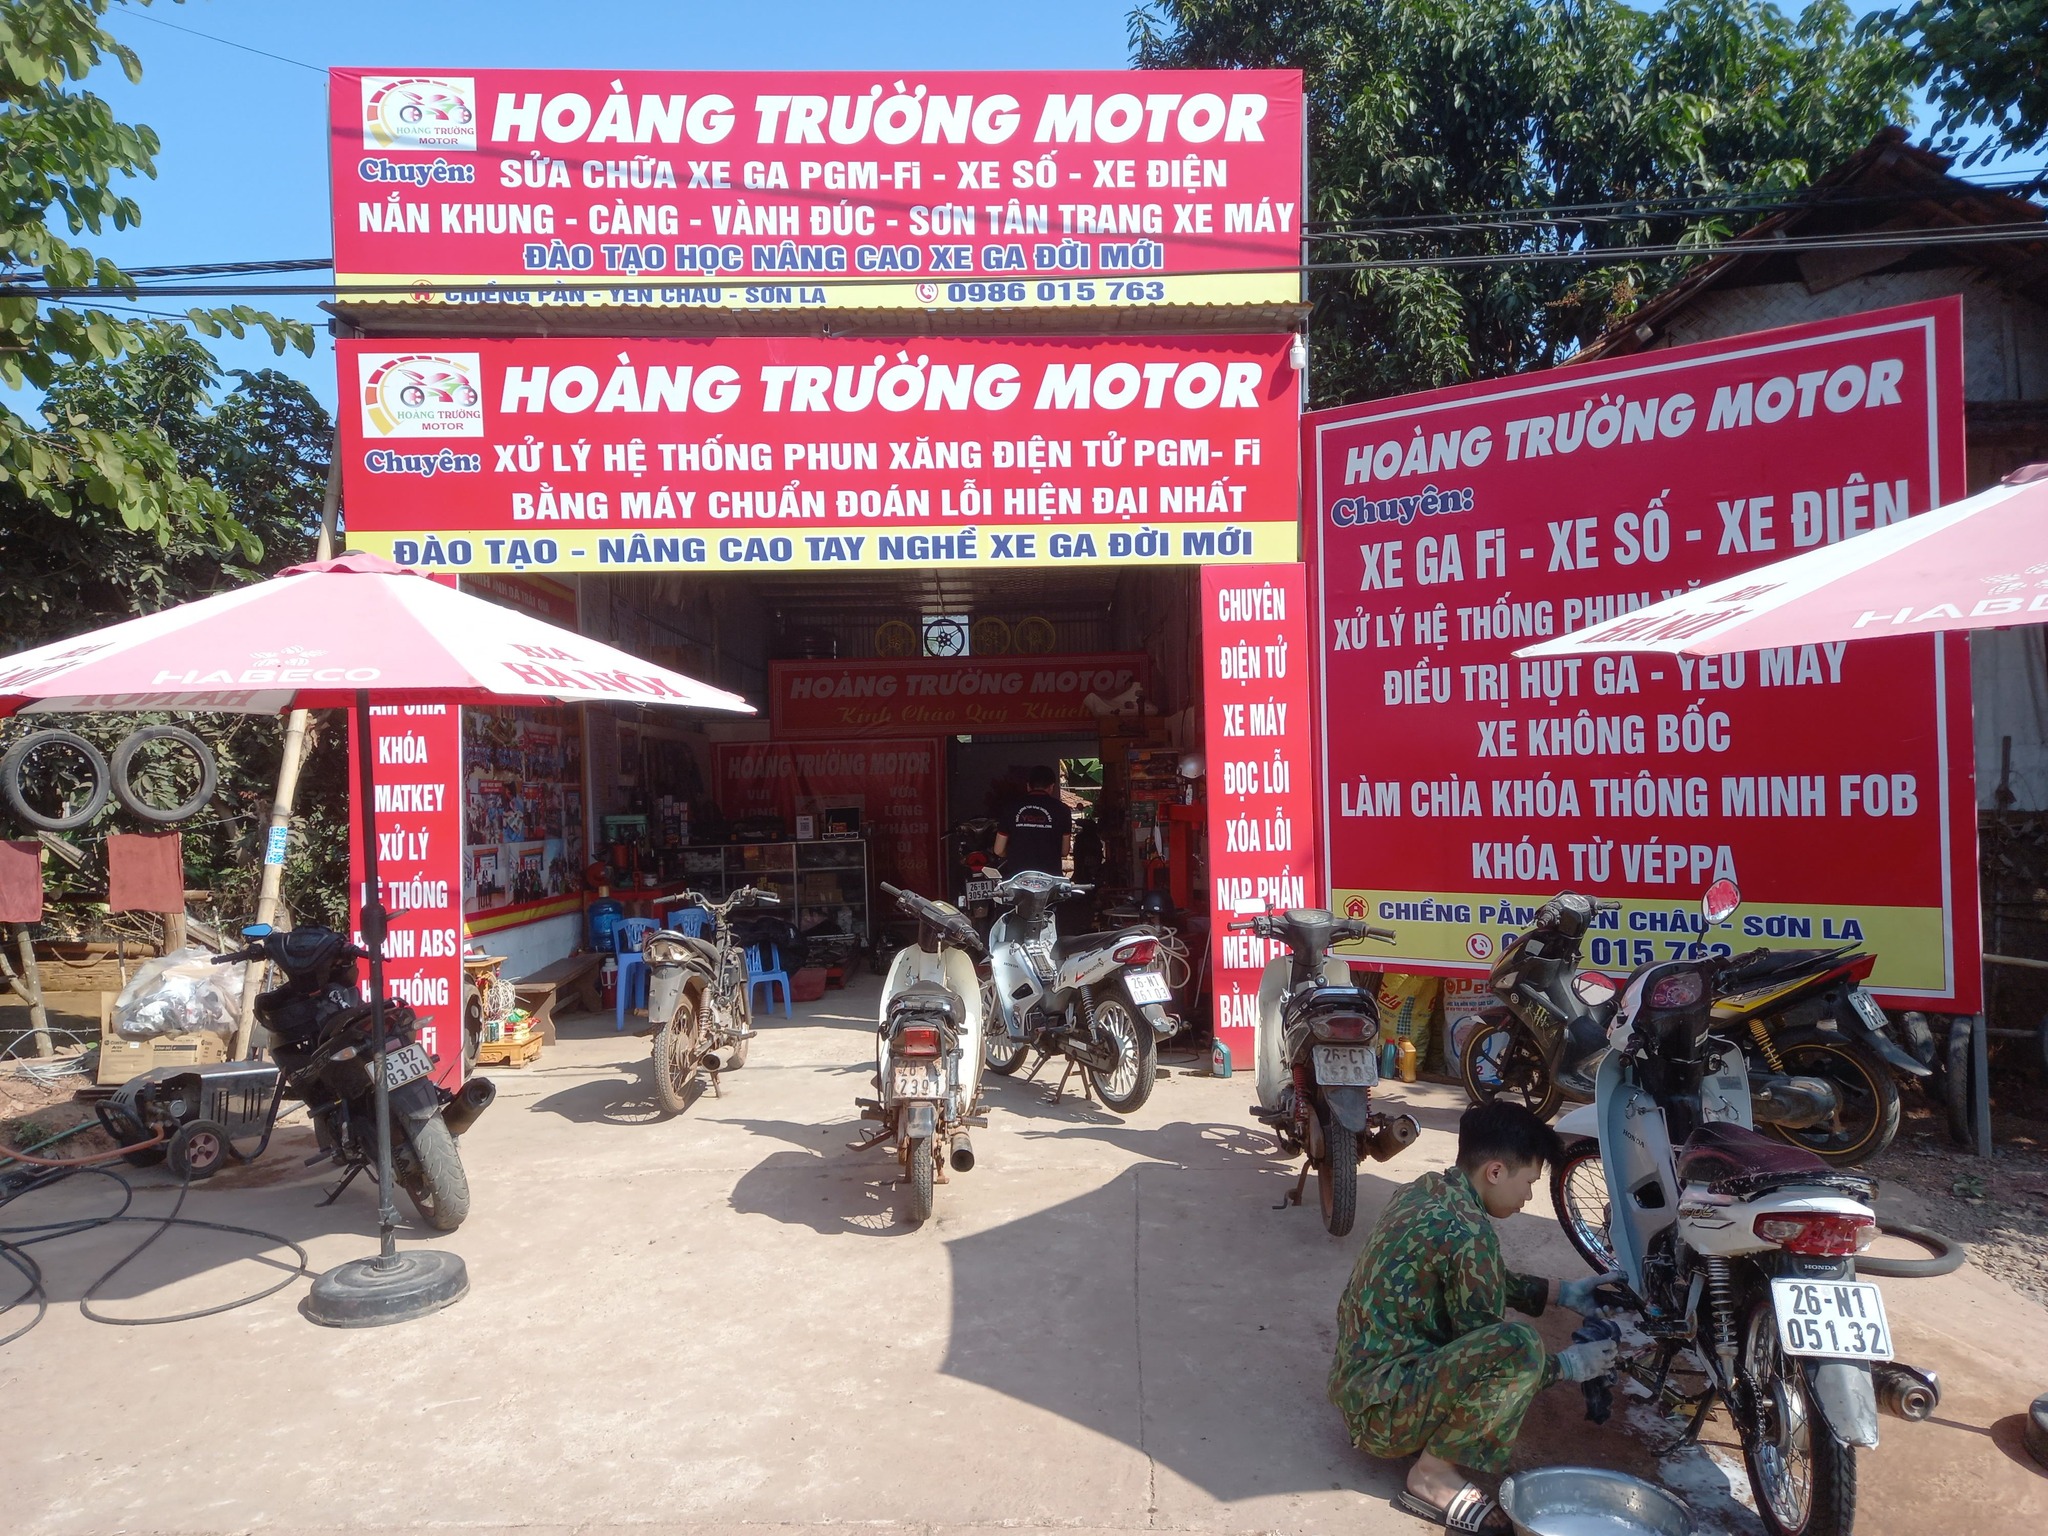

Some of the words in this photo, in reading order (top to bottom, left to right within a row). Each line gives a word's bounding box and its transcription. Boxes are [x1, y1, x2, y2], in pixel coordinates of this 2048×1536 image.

[490, 78, 735, 144] HOÀNG
[754, 79, 1020, 145] TRƯỜNG
[1033, 93, 1267, 145] MOTOR
[359, 158, 475, 185] Chuyên:
[500, 150, 570, 189] SỬA
[583, 154, 675, 189] CHỮA
[688, 160, 731, 190] XE
[743, 160, 789, 189] GA
[957, 160, 999, 190] XE
[1012, 150, 1057, 189] SỐ
[1093, 159, 1136, 189] XE
[1147, 154, 1227, 194] ĐIỆN
[359, 191, 430, 234] NẮN
[442, 203, 555, 235] KHUNG
[589, 199, 679, 236] CÀNG
[712, 199, 799, 235] VÀNH
[810, 200, 875, 236] ĐÚC
[909, 202, 975, 236] SƠN
[986, 199, 1047, 235] TÂN
[1059, 203, 1162, 235] TRANG
[1173, 203, 1213, 233] XE
[1224, 197, 1295, 233] MÁY
[524, 241, 592, 271] ĐÀO
[602, 244, 665, 275] TẠO
[677, 245, 741, 275] HỌC
[754, 242, 845, 271] NÂNG
[856, 245, 919, 271] CAO
[932, 245, 971, 271] XE
[983, 245, 1025, 271] GA
[1035, 240, 1090, 270] ĐỜI
[1100, 240, 1163, 269] MỚI
[800, 287, 826, 303] LA
[947, 282, 1026, 302] 0986
[1037, 281, 1095, 301] 015
[1105, 281, 1164, 300] 763
[500, 351, 741, 414] HOÀNG
[760, 350, 1021, 412] TRƯỜNG
[1033, 362, 1262, 410] MOTOR
[421, 422, 464, 431] MOTOR
[1344, 425, 1493, 486] HOÀNG
[1505, 392, 1696, 462] TRƯỜNG
[1706, 358, 1904, 432] MOTOR
[365, 448, 481, 477] Chuyên:
[494, 436, 544, 472] XỬ
[558, 438, 591, 472] LÝ
[604, 440, 646, 478] HỆ
[658, 434, 772, 472] THỐNG
[784, 443, 878, 471] PHUN
[888, 435, 981, 469] XĂNG
[993, 435, 1071, 474] ĐIỆN
[1082, 430, 1126, 467] TỬ
[512, 481, 608, 521] BẰNG
[620, 485, 696, 519] MÁY
[708, 479, 825, 519] CHUẨN
[836, 483, 930, 518] ĐOÁN
[941, 478, 992, 516] LỖI
[1004, 482, 1081, 521] HIỆN
[1092, 485, 1148, 520] ĐẠI
[1159, 476, 1246, 513] NHẤT
[1332, 484, 1474, 527] Chuyên:
[394, 535, 472, 566] ĐÀO
[485, 538, 558, 569] TẠO
[600, 533, 705, 563] NÂNG
[718, 536, 793, 563] CAO
[804, 535, 865, 561] TAY
[879, 526, 978, 561] NGHỀ
[990, 533, 1036, 558] XE
[1049, 532, 1097, 558] GA
[1108, 526, 1169, 557] ĐỜI
[1183, 526, 1252, 556] MỚI
[1360, 541, 1403, 591] XE
[1415, 534, 1464, 585] GA
[1476, 528, 1506, 579] Fi
[1548, 516, 1599, 572] XE
[1613, 489, 1671, 566] SỐ
[1717, 496, 1775, 555] XE
[1219, 581, 1286, 622] CHUYÊN
[1334, 606, 1371, 651] XỬ
[1376, 603, 1405, 646] LÝ
[1414, 603, 1448, 651] HỆ
[1457, 592, 1553, 641] THỐNG
[151, 668, 381, 685] HABECO
[1220, 639, 1260, 686] ĐIỆN
[1265, 634, 1287, 678] TỬ
[790, 670, 898, 700] HOÀNG
[906, 667, 1024, 696] TRƯỜNG
[1029, 670, 1134, 694] MOTOR
[1384, 656, 1450, 705] ĐIỀU
[1461, 662, 1509, 708] TRỊ
[1521, 658, 1582, 706] HỤT
[1593, 655, 1639, 696] GA
[1223, 704, 1245, 737] XE
[1250, 696, 1287, 736] MÁY
[1477, 720, 1517, 758] XE
[1529, 709, 1645, 756] KHÔNG
[1657, 698, 1731, 753] BỐC
[379, 730, 428, 764] KHÓA
[728, 750, 792, 779] HOÀNG
[869, 751, 930, 775] MOTOR
[1224, 761, 1258, 801] ĐỌC
[1264, 749, 1290, 794] LỖI
[1341, 775, 1401, 817] LÀM
[1411, 773, 1482, 818] CHÌA
[1491, 772, 1580, 817] KHÓA
[1590, 769, 1709, 818] THÔNG
[1722, 775, 1826, 817] MINH
[1840, 774, 1918, 817] FOB
[375, 784, 445, 812] MATKEY
[379, 824, 406, 861] XỬ
[409, 827, 429, 860] LÝ
[1226, 813, 1261, 852] XÓA
[1265, 806, 1291, 851] LỖI
[1472, 835, 1559, 881] KHÓA
[1569, 835, 1613, 882] TỪ
[1621, 836, 1738, 885] VÉPPA
[388, 871, 448, 909] THỐNG
[1258, 865, 1304, 910] PHẦN
[1379, 898, 1471, 923] CHIỀNG
[1629, 909, 1709, 933] CHÂU
[1743, 914, 1811, 937] SƠN
[1823, 918, 1864, 941] LA
[420, 929, 456, 958] ABS
[1591, 938, 1653, 966] 015
[389, 969, 448, 1007] THỐNG
[1323, 1048, 1365, 1064] 26-C1
[901, 1079, 939, 1097] 2391
[1623, 1129, 1645, 1148] HONDA
[1789, 1284, 1867, 1319] 26-N1
[1787, 1319, 1886, 1355] 051.32
[1450, 1520, 1474, 1530] SPORT
